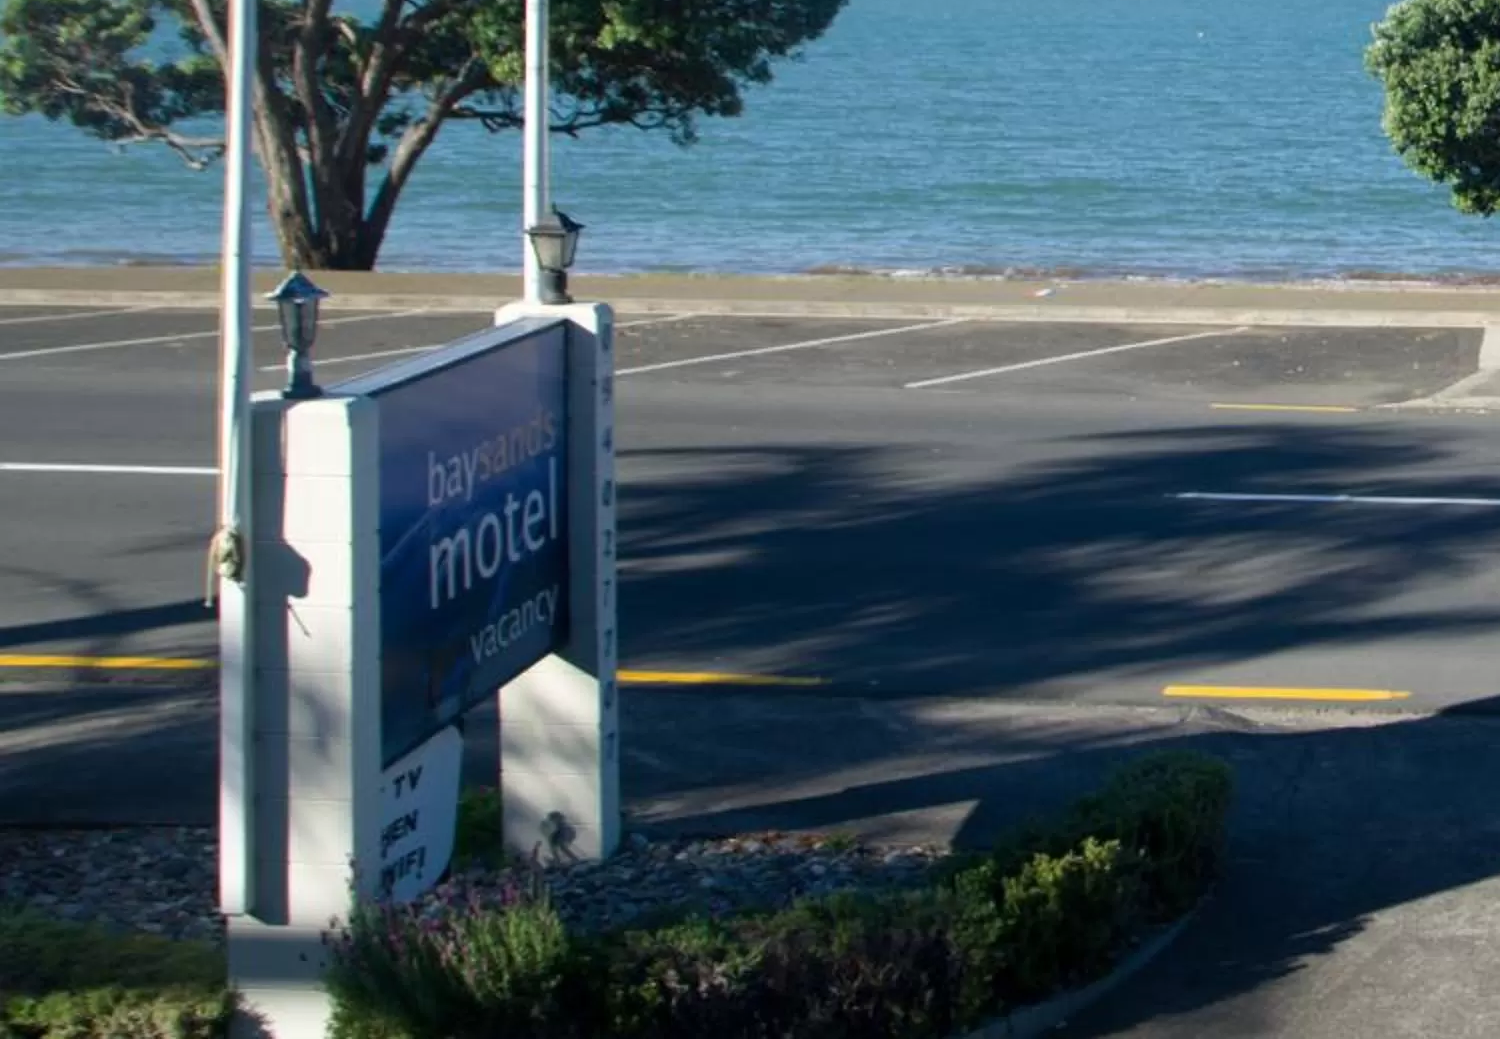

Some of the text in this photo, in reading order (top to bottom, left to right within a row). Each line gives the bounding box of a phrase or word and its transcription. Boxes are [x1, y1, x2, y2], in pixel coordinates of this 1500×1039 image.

[427, 409, 556, 508] baysands
[430, 457, 557, 610] motel
[470, 584, 559, 665] vacancy
[392, 764, 423, 799] TV
